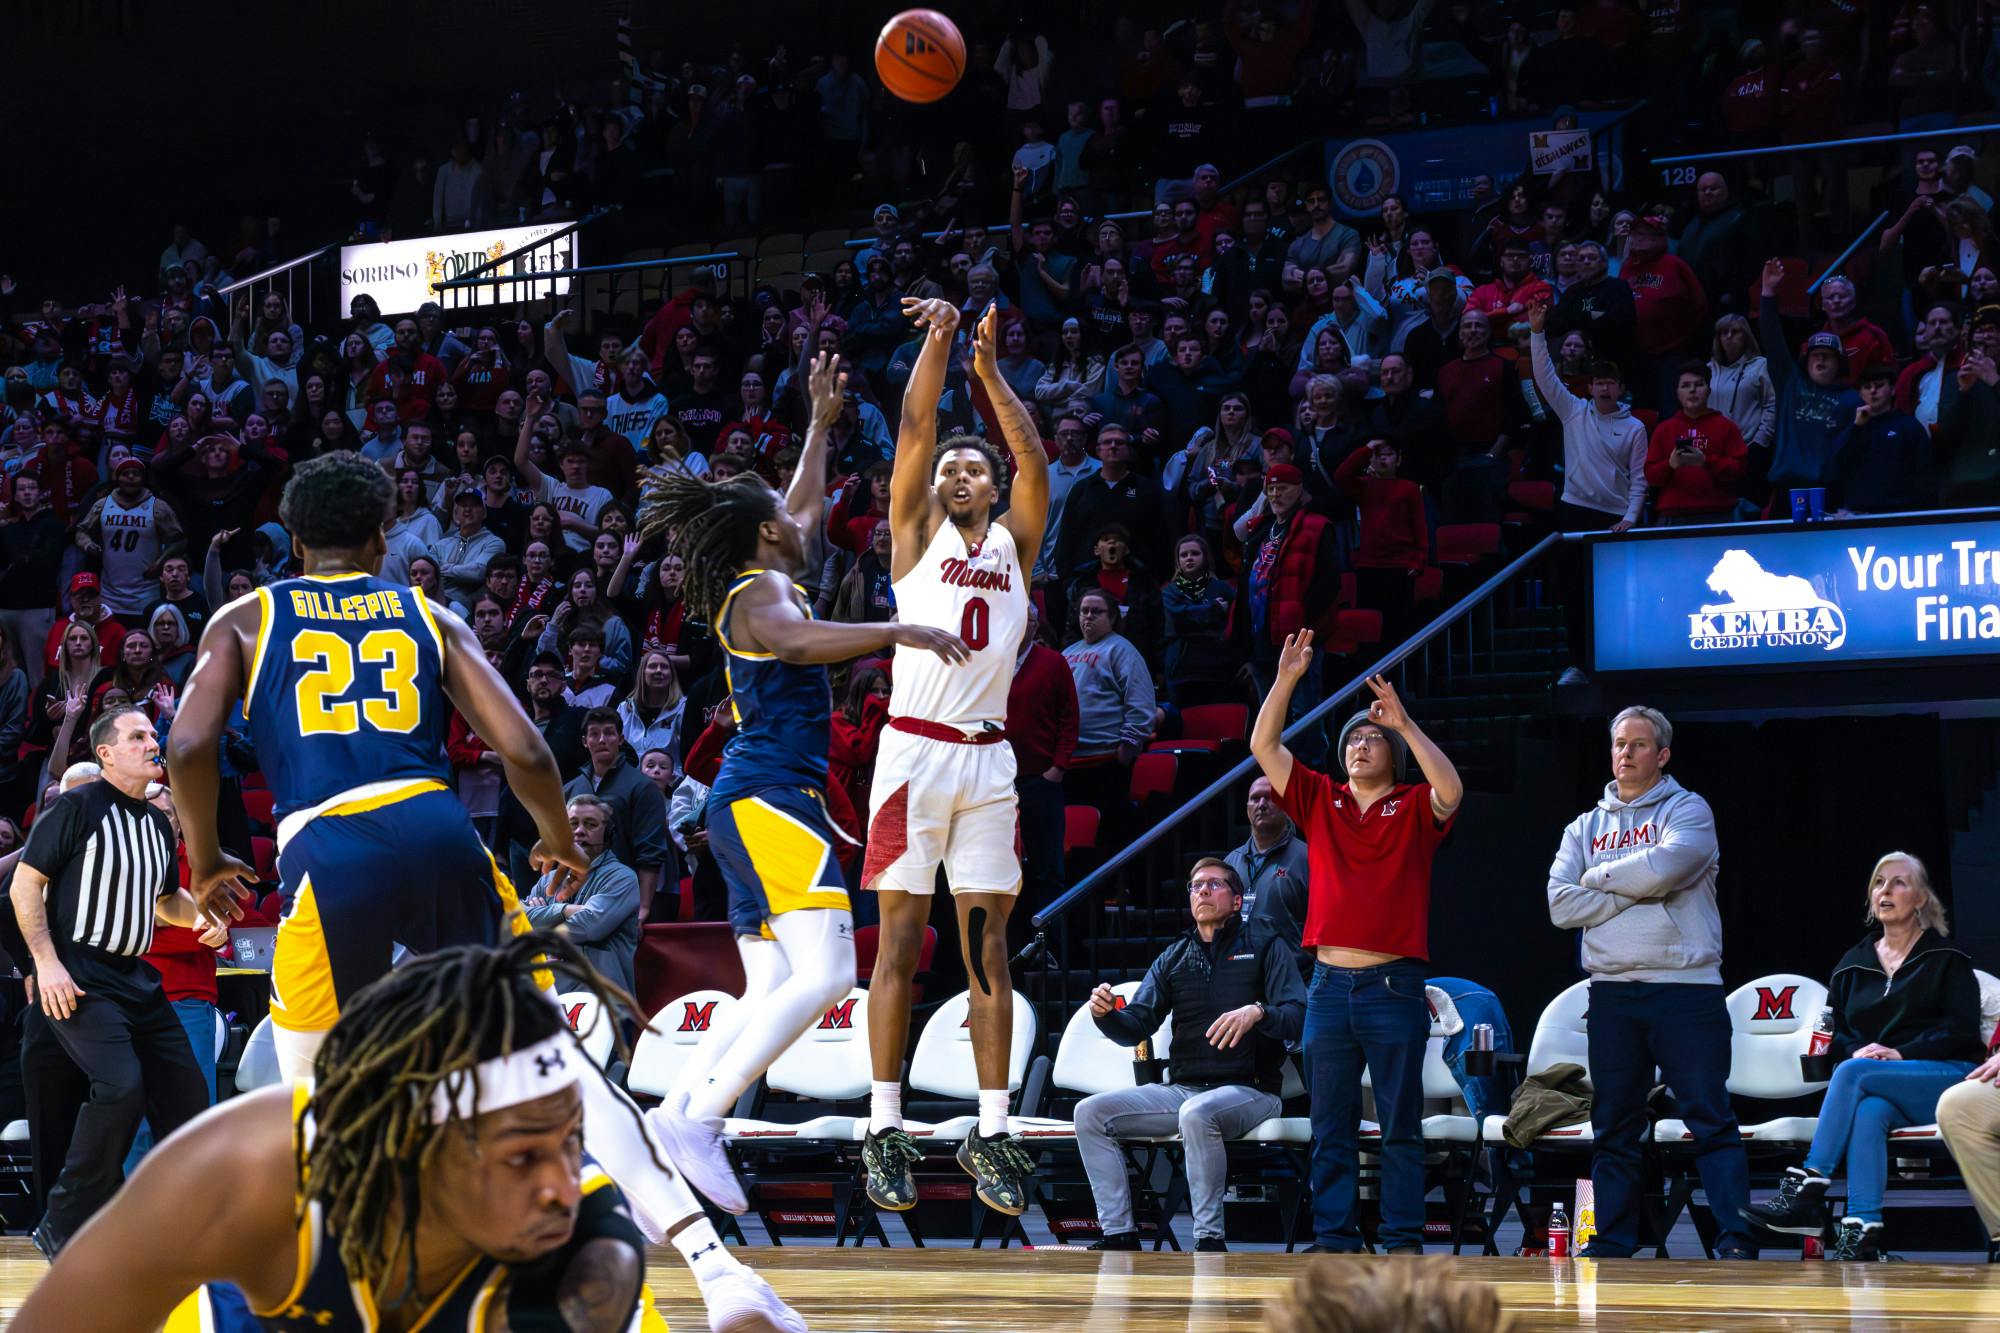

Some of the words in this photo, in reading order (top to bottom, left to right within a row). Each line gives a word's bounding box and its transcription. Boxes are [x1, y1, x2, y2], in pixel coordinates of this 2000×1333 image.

[1661, 166, 1697, 186] 128
[342, 261, 419, 286] SORRISO
[105, 514, 147, 528] MIAMI
[111, 530, 140, 552] 40
[940, 557, 1011, 592] Miami
[1848, 546, 1943, 592] Your
[289, 589, 405, 620] GILLESPIE
[1916, 594, 2000, 641] Fina
[961, 596, 989, 651] 0
[1688, 607, 1839, 638] KEMBA
[1690, 634, 1762, 650] CREDIT
[1766, 630, 1833, 647] UNION
[291, 628, 420, 737] 23
[1591, 823, 1658, 856] MIAMI
[676, 1001, 719, 1031] M
[817, 998, 860, 1029] M
[1751, 986, 1800, 1020] M
[1581, 1209, 1595, 1227] PO
